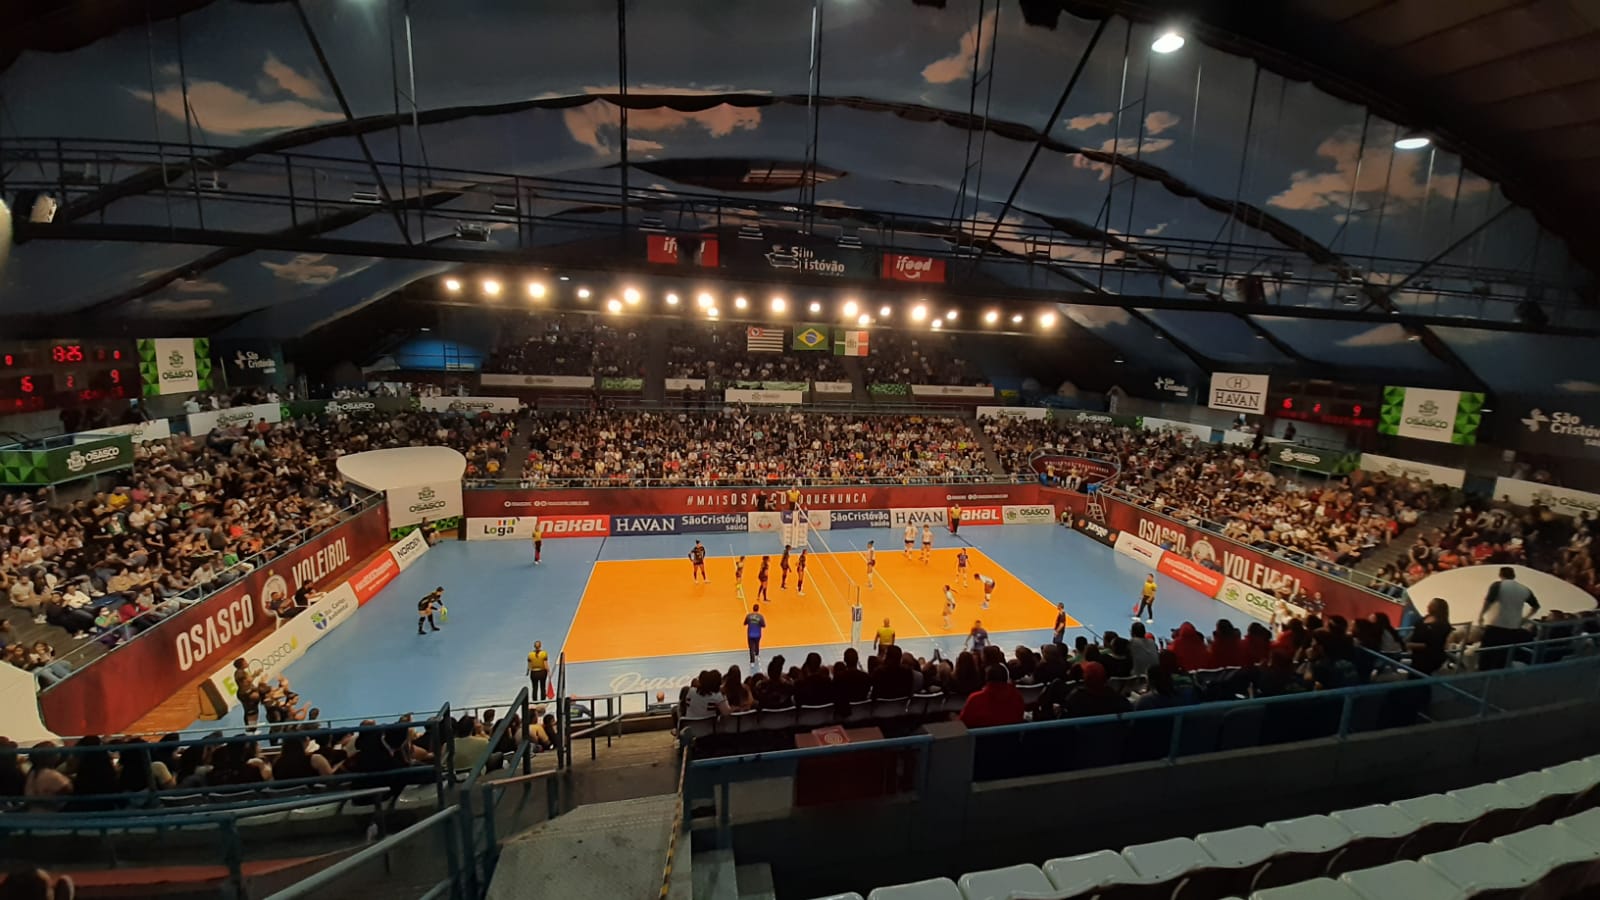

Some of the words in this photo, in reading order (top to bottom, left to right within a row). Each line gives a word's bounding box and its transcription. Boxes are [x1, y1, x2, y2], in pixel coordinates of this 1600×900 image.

[162, 369, 194, 380] OSASCO
[1215, 391, 1259, 407] HAVAN
[1405, 416, 1448, 430] OSASCO
[1551, 411, 1581, 425] São
[85, 446, 120, 462] OSASCO
[409, 500, 446, 512] OSASCO
[1020, 508, 1050, 516] OSASCO
[896, 511, 943, 524] HAVAN
[484, 525, 514, 536] Loga
[615, 518, 675, 532] HAVAN
[176, 594, 254, 671] OSASCO
[292, 536, 350, 590] VOLEIBOL
